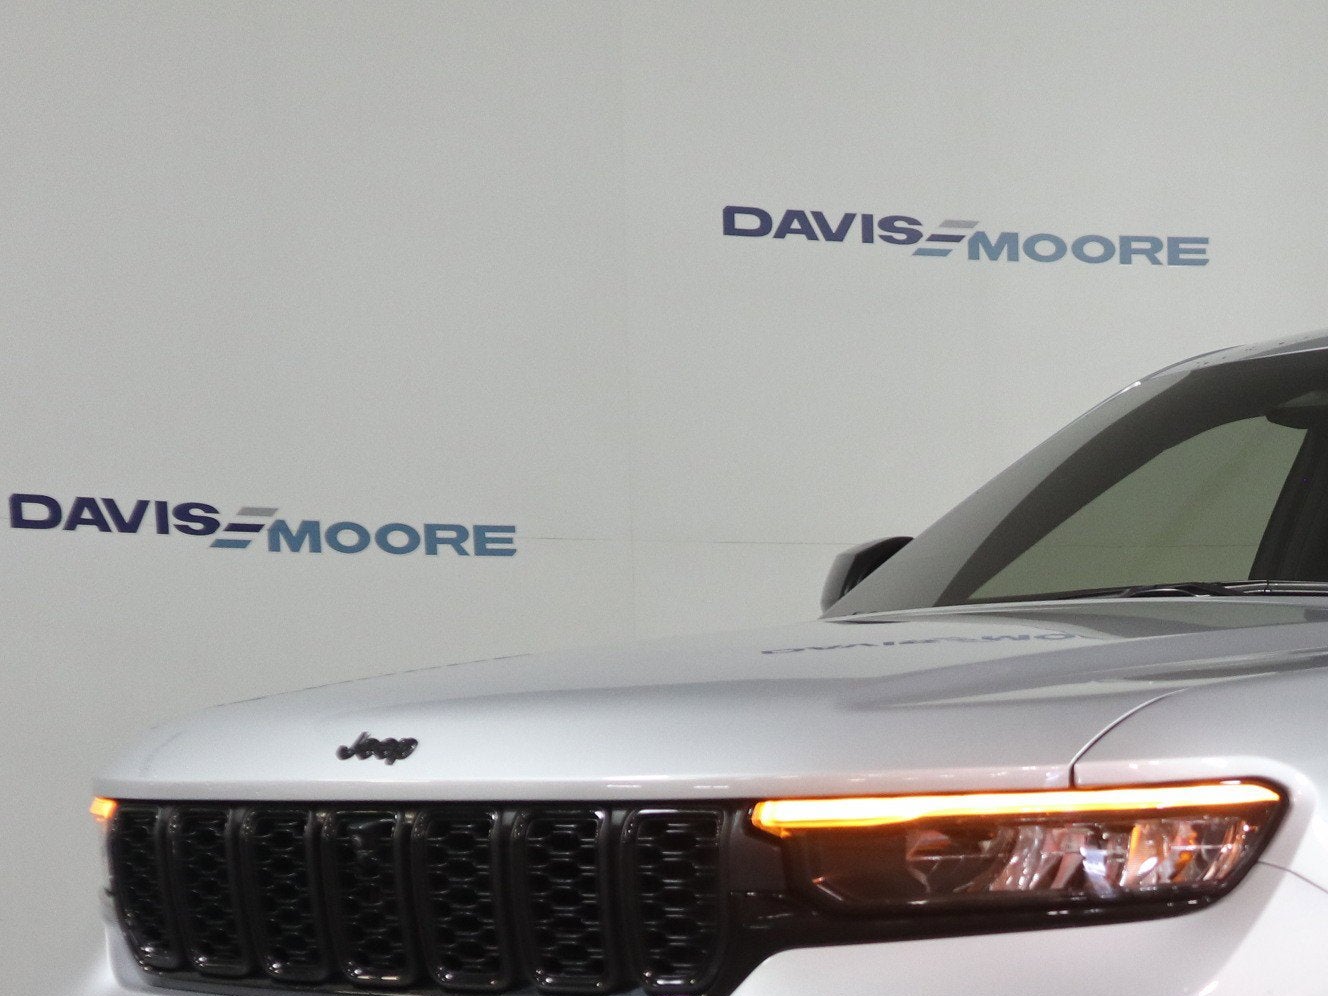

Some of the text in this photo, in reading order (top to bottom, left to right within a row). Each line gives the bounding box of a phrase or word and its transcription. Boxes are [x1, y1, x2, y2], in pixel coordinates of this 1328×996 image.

[722, 205, 1210, 266] DAVIS MOORE
[9, 493, 517, 556] DAVIS MOORE
